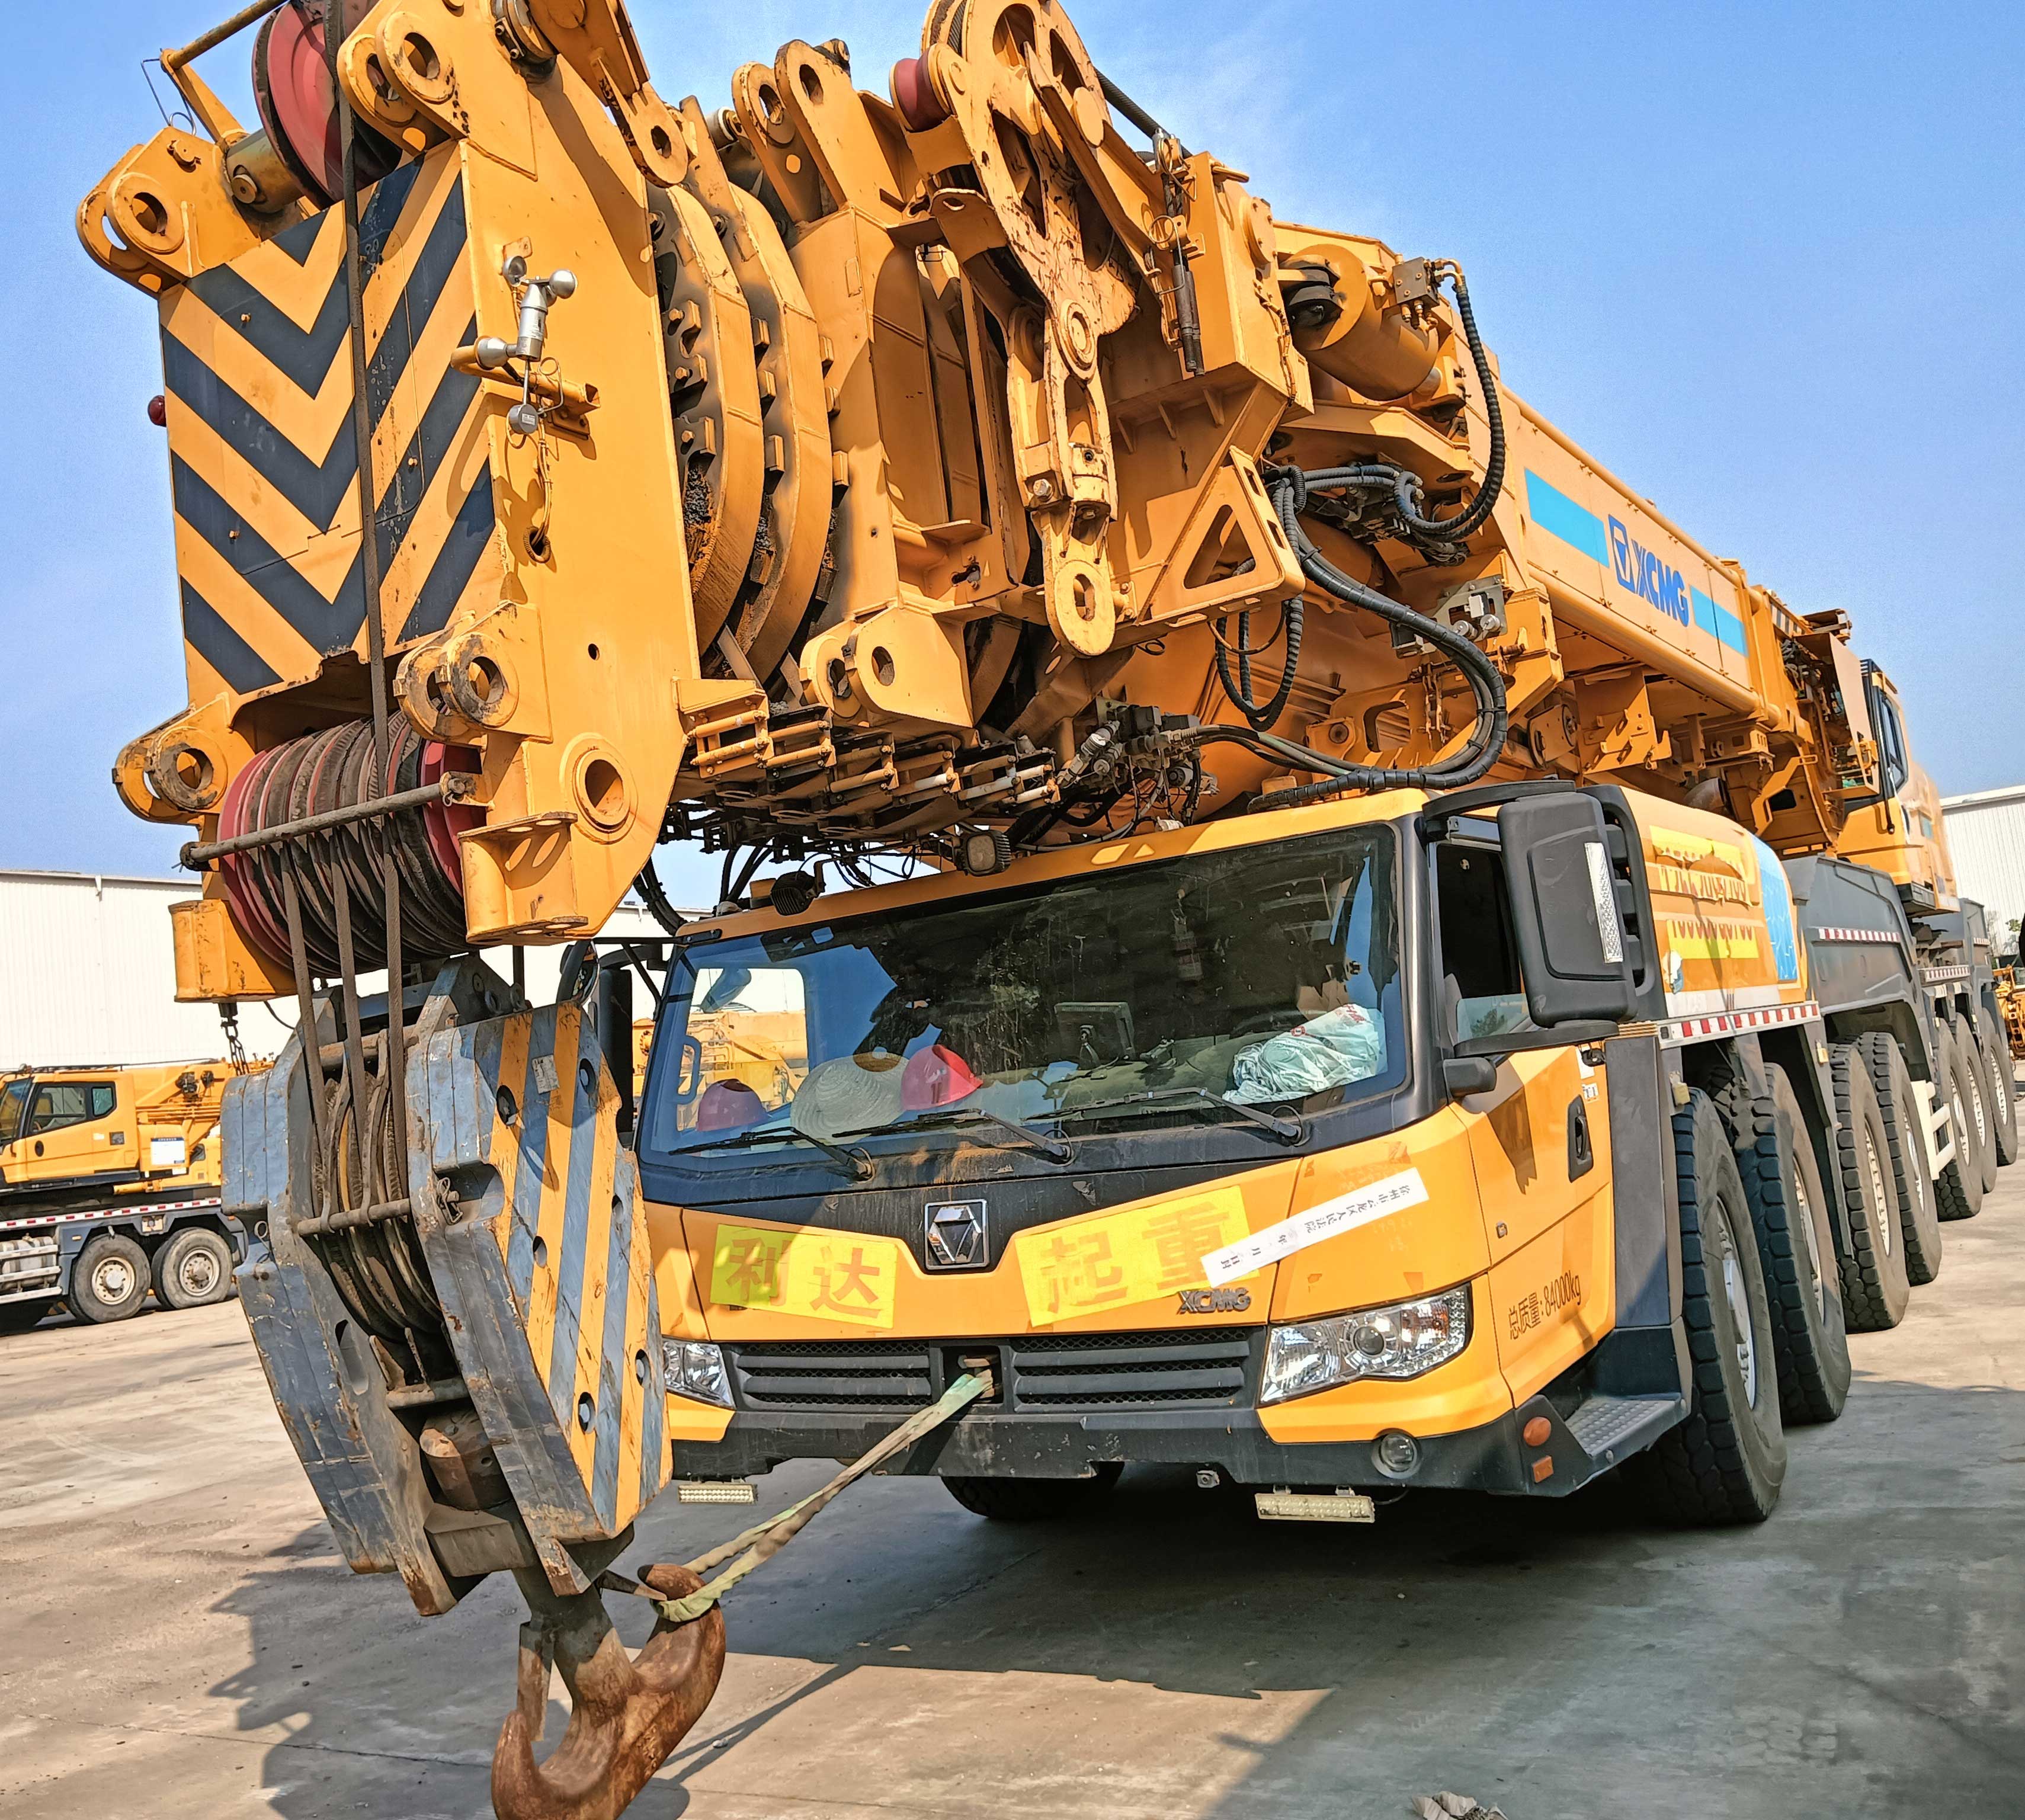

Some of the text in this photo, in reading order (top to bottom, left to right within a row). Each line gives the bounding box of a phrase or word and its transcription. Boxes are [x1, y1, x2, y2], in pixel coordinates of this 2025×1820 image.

[1632, 539, 1688, 627] XCMG
[1305, 1185, 1410, 1233] 徐州市云龙区人民法院
[725, 1201, 1230, 1318] 利达 起重
[1176, 1287, 1251, 1314] XCMG
